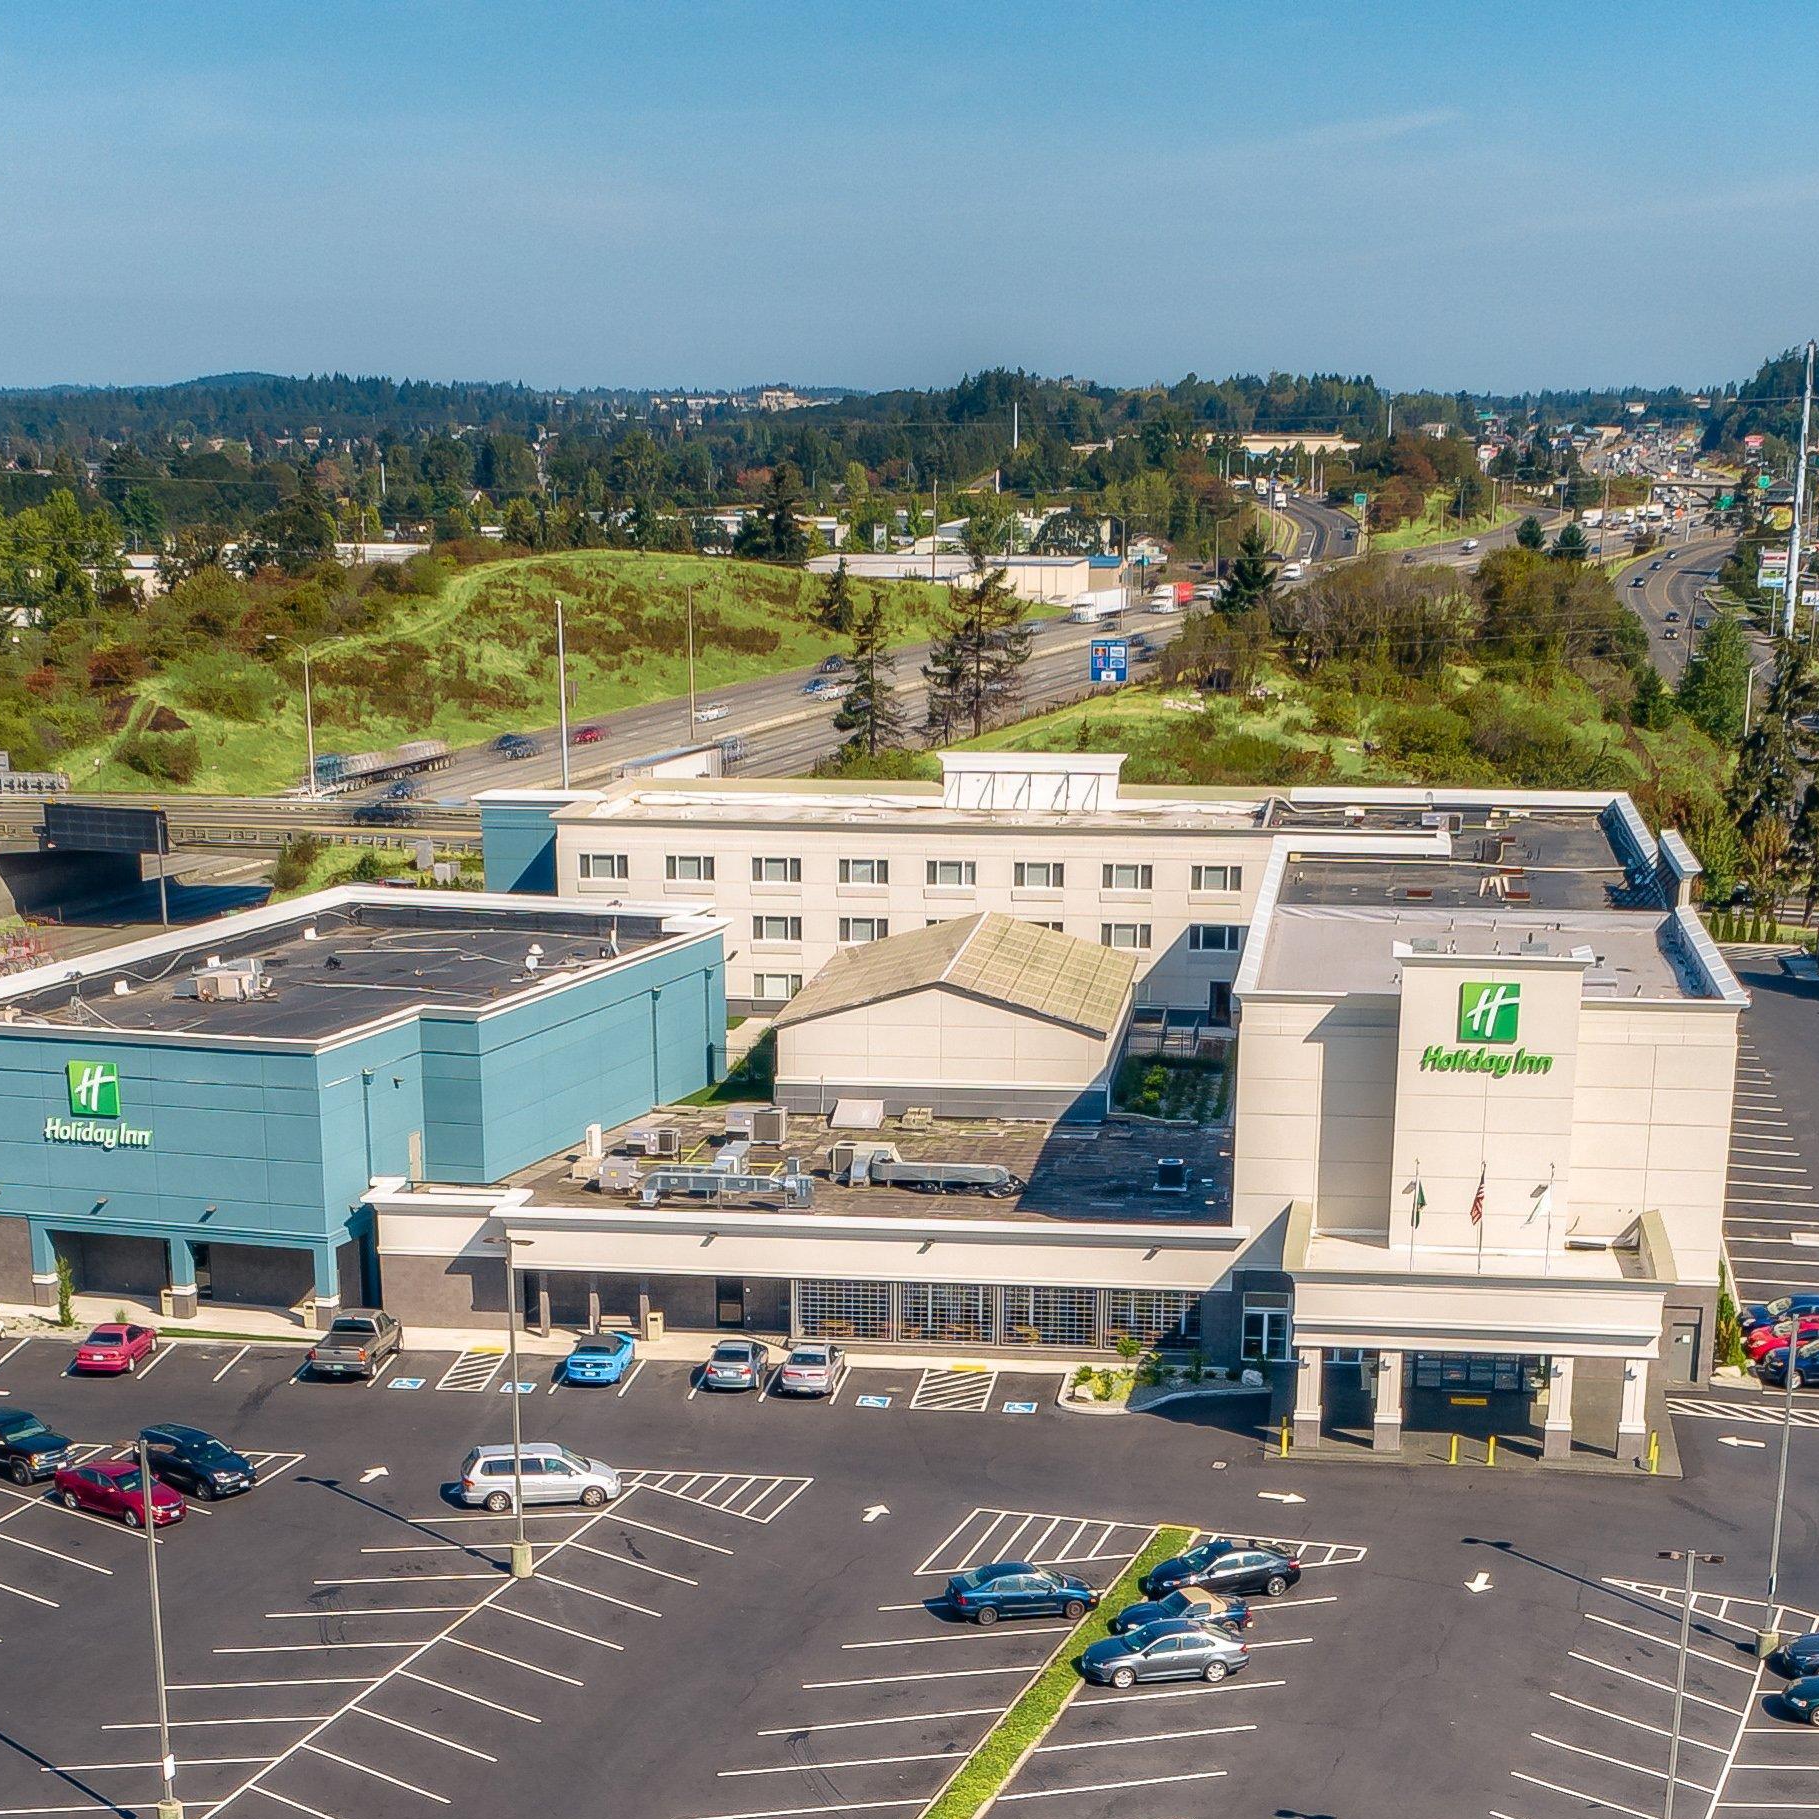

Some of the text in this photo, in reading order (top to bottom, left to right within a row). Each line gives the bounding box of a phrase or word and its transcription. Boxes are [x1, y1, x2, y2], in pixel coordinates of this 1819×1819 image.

[1420, 1046, 1553, 1078] Holiday Inn
[44, 1117, 153, 1149] Holiday Inn
